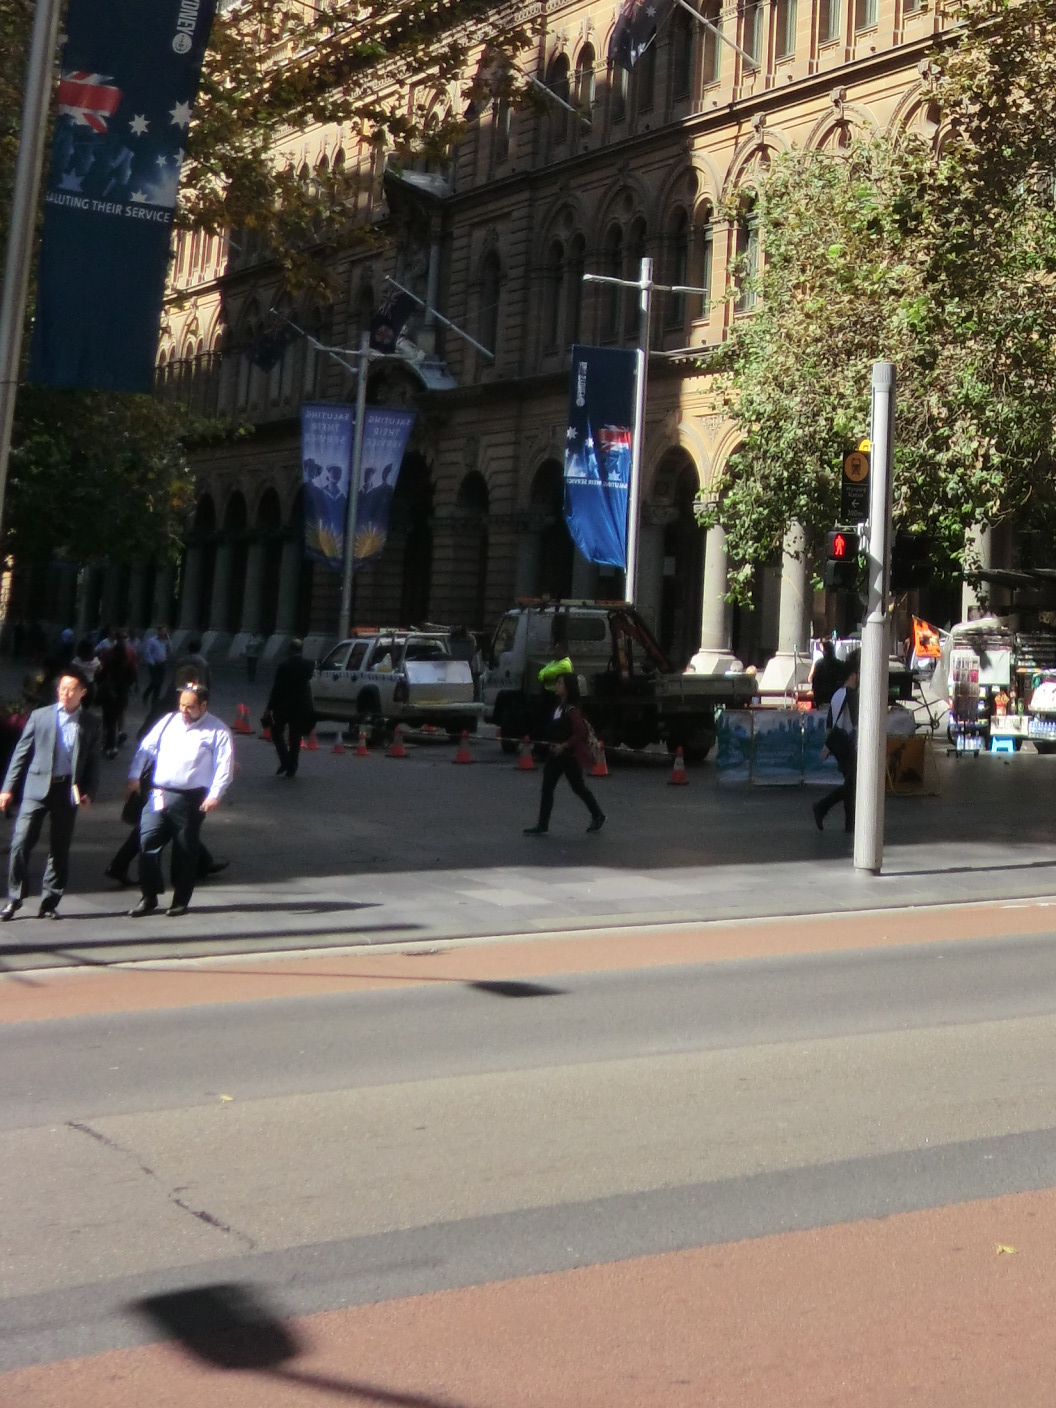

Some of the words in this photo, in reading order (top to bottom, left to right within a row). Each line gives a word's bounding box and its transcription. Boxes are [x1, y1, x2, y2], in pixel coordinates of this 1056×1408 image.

[45, 191, 89, 210] SALUTING
[92, 200, 122, 215] THEIR
[125, 206, 171, 223] SERVICE
